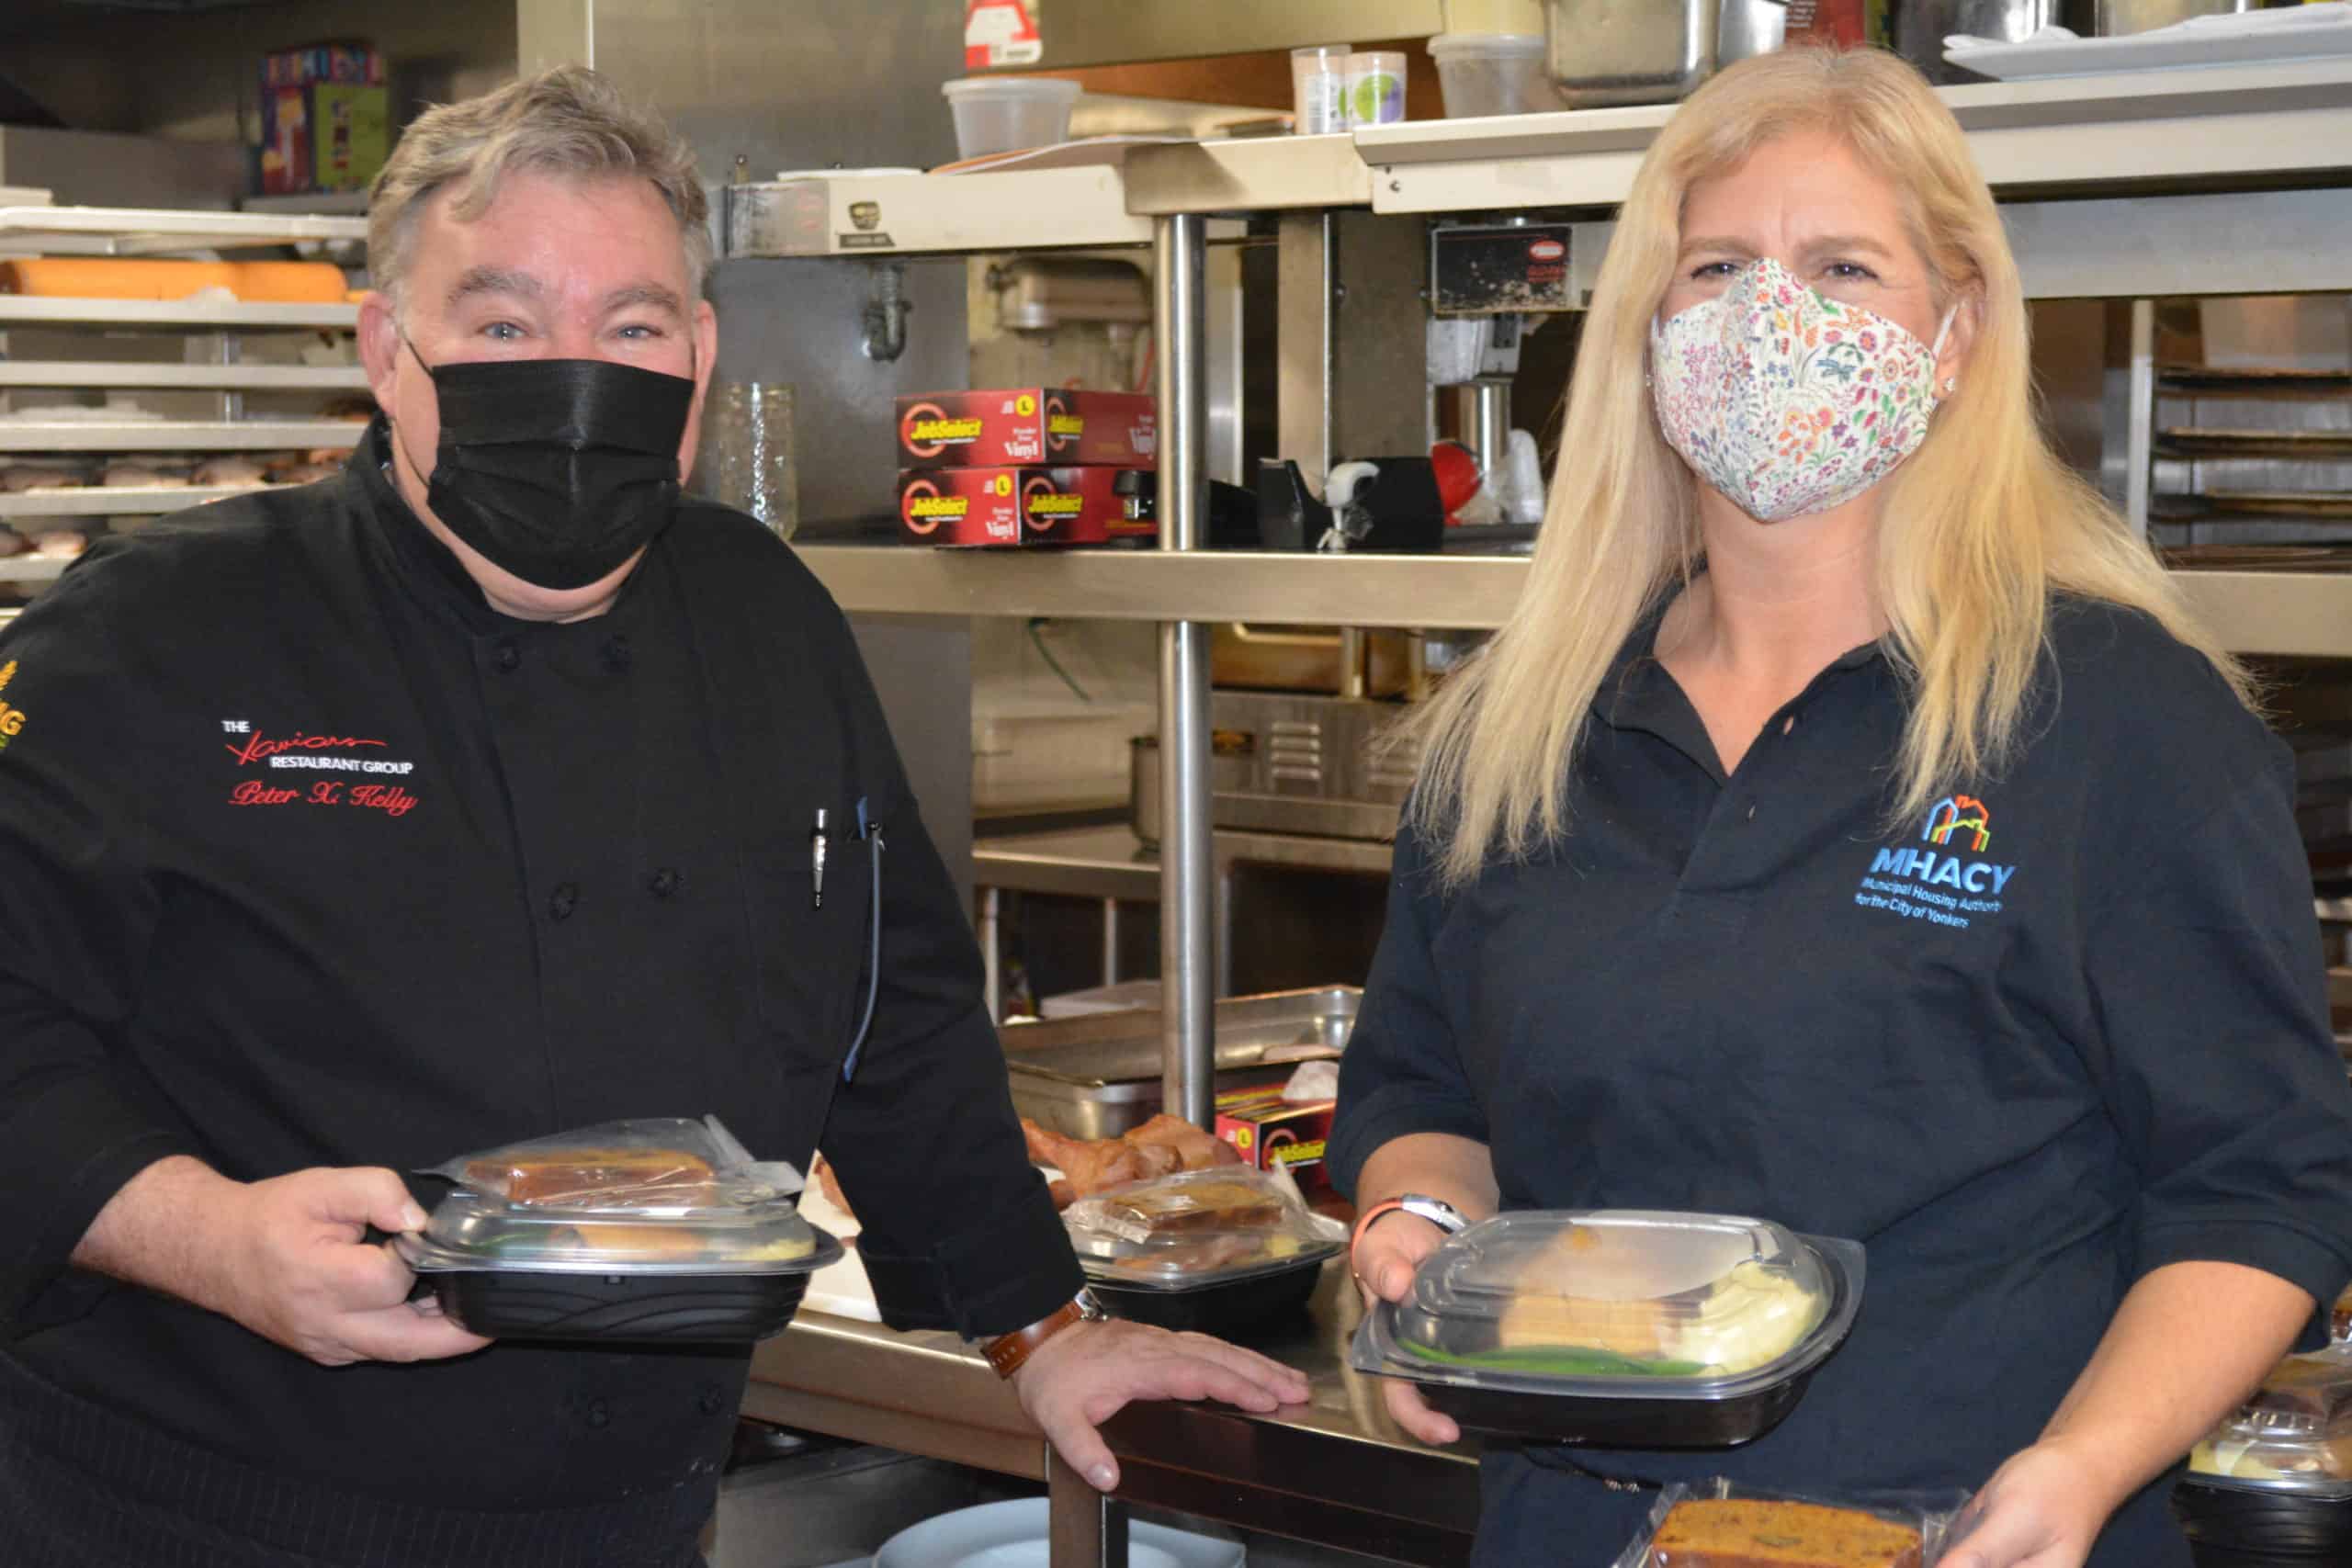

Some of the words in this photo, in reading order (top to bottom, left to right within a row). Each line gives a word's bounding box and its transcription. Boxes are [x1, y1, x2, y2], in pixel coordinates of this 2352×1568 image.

[1003, 440, 1039, 460] Vinyl
[985, 521, 1015, 540] Vinyl
[221, 719, 250, 733] THE
[269, 755, 361, 773] RESTAURANT
[362, 761, 413, 774] GROUP
[228, 780, 300, 807] Peter
[349, 784, 419, 817] Kelly
[1869, 847, 2016, 897] MHACY
[1912, 885, 1958, 910] Housing
[1888, 897, 1912, 917] City
[1912, 906, 1927, 919] of
[1927, 907, 1971, 930] Yonkers
